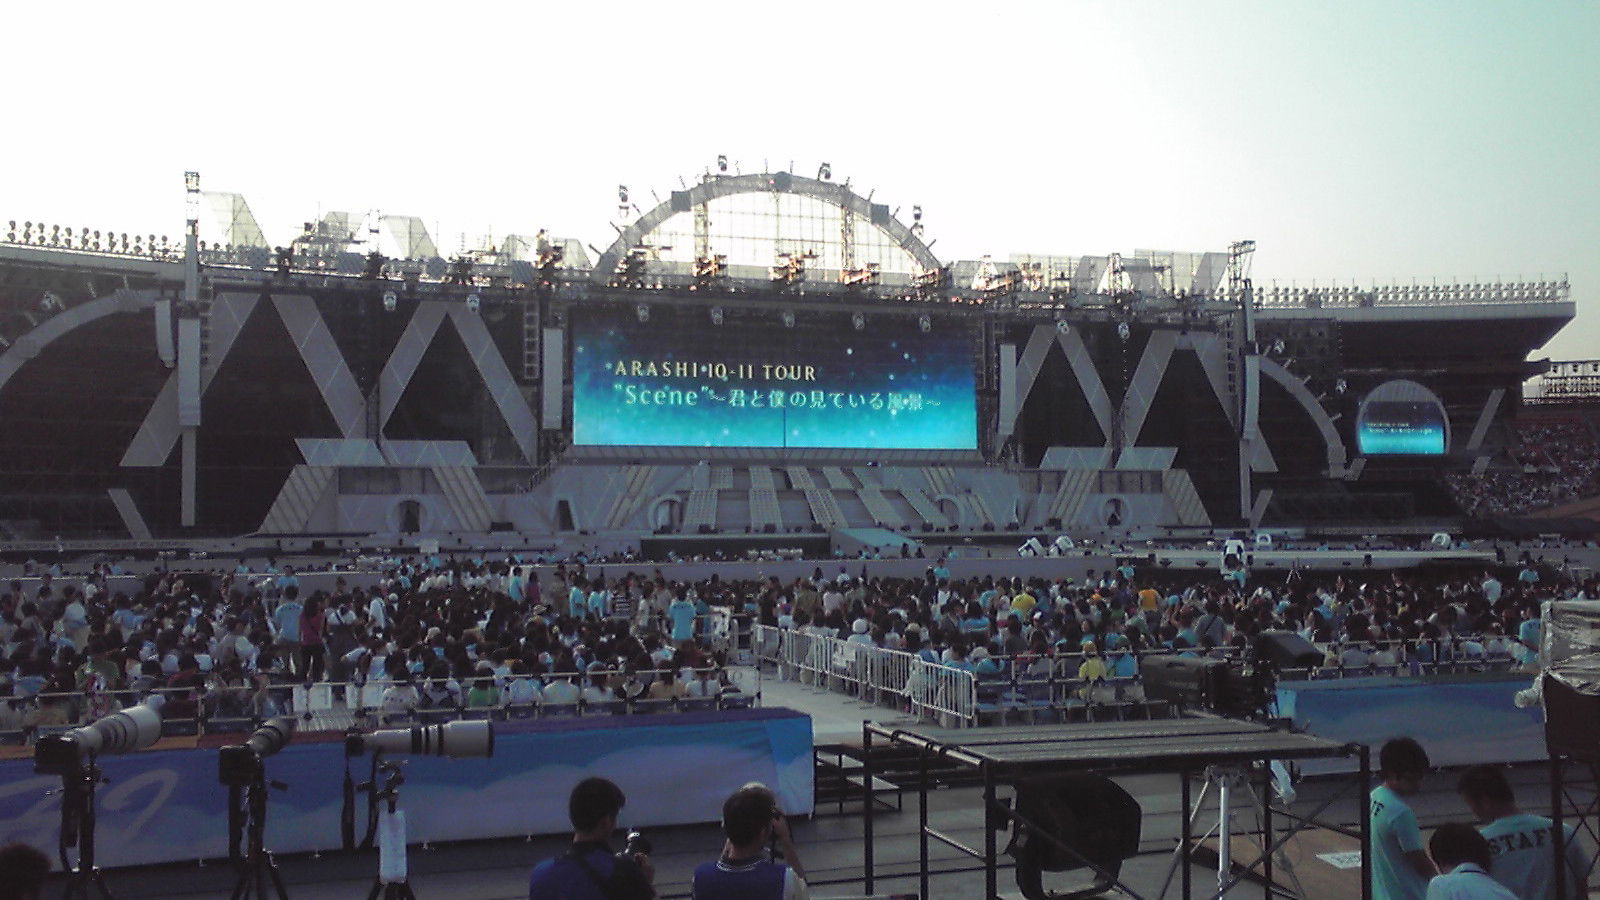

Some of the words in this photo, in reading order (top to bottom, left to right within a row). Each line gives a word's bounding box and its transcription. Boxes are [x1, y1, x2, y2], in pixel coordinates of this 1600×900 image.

[615, 361, 698, 378] ARASHI
[762, 364, 816, 380] TOUR
[1488, 827, 1553, 856] STAF
